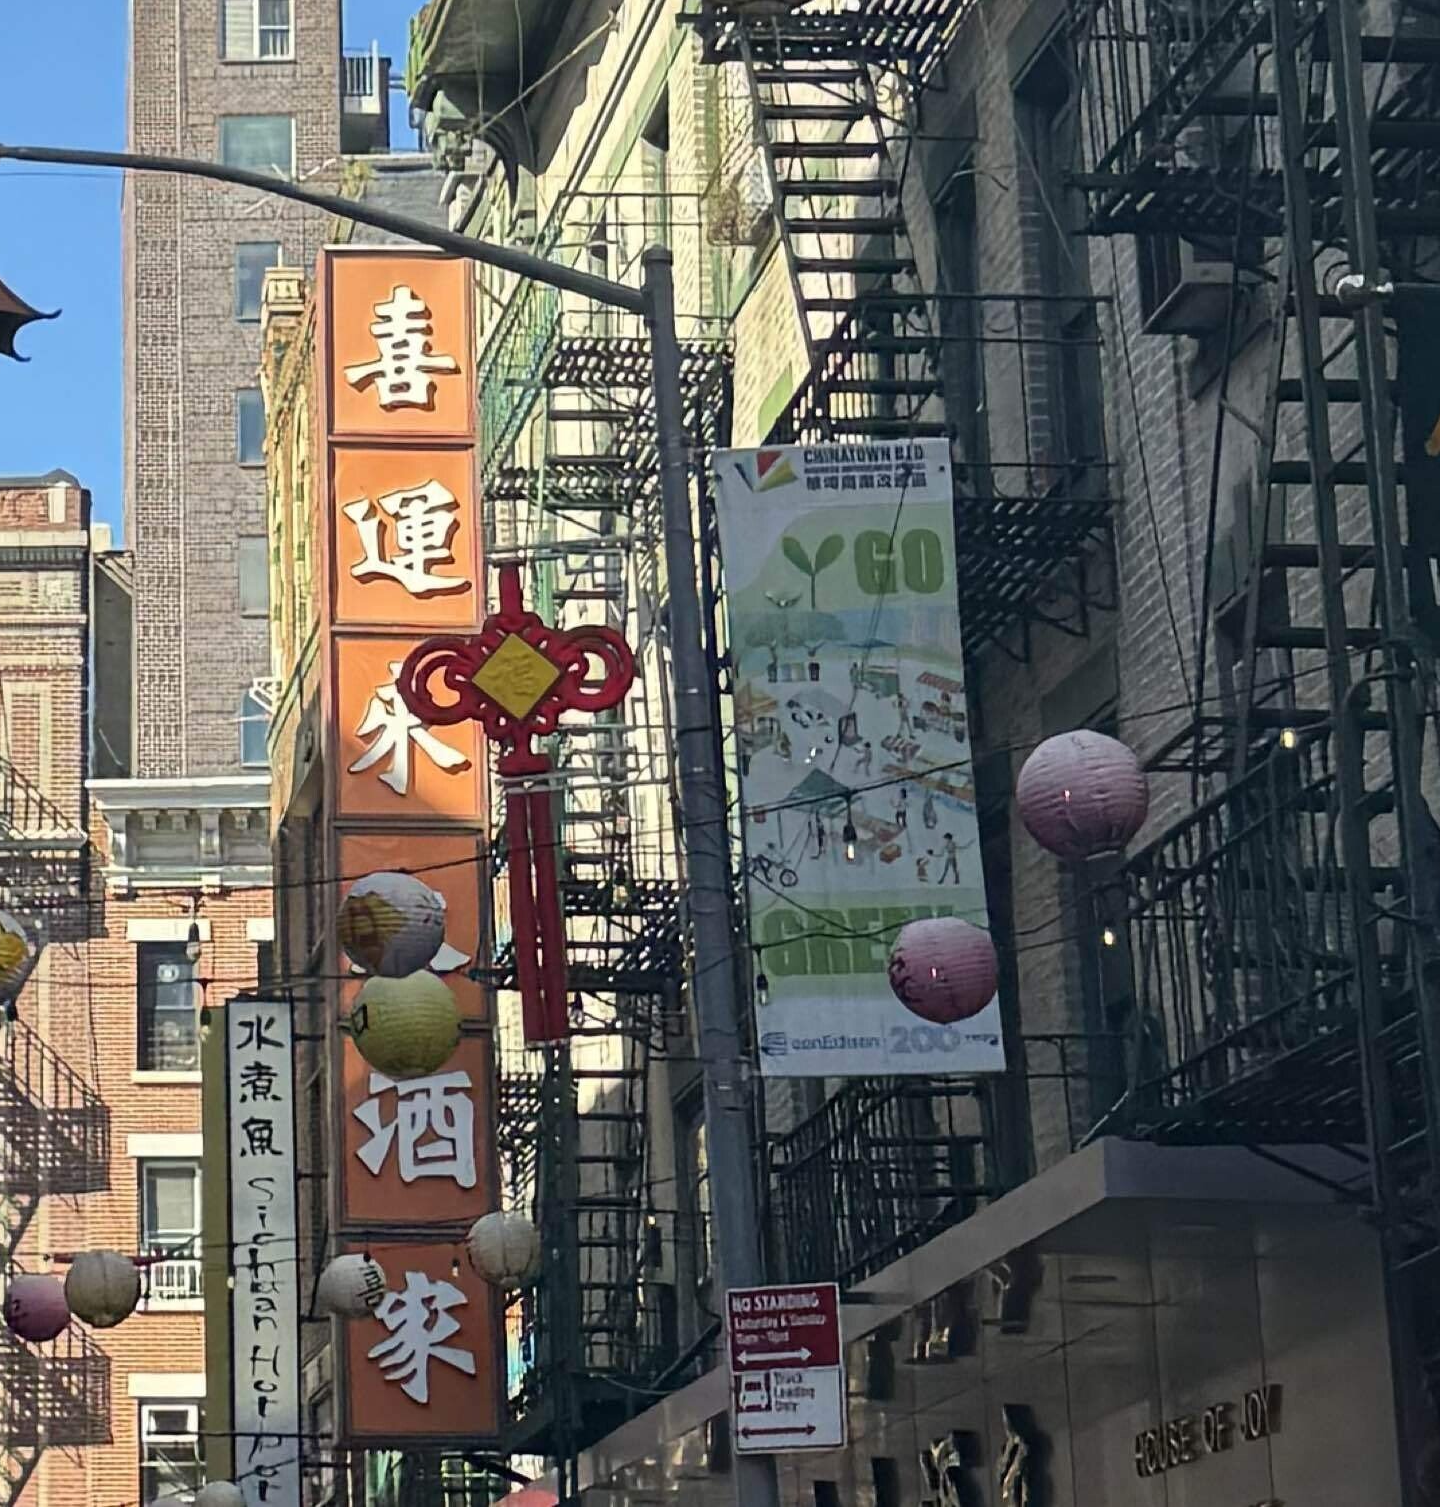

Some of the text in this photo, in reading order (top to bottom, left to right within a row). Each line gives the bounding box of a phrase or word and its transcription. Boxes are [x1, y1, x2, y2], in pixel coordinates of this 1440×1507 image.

[853, 527, 945, 595] GO
[343, 284, 477, 1404] 喜運來酒家
[763, 905, 955, 977] GRE
[732, 1292, 820, 1314] NO STANDING
[1201, 1403, 1230, 1454] OF
